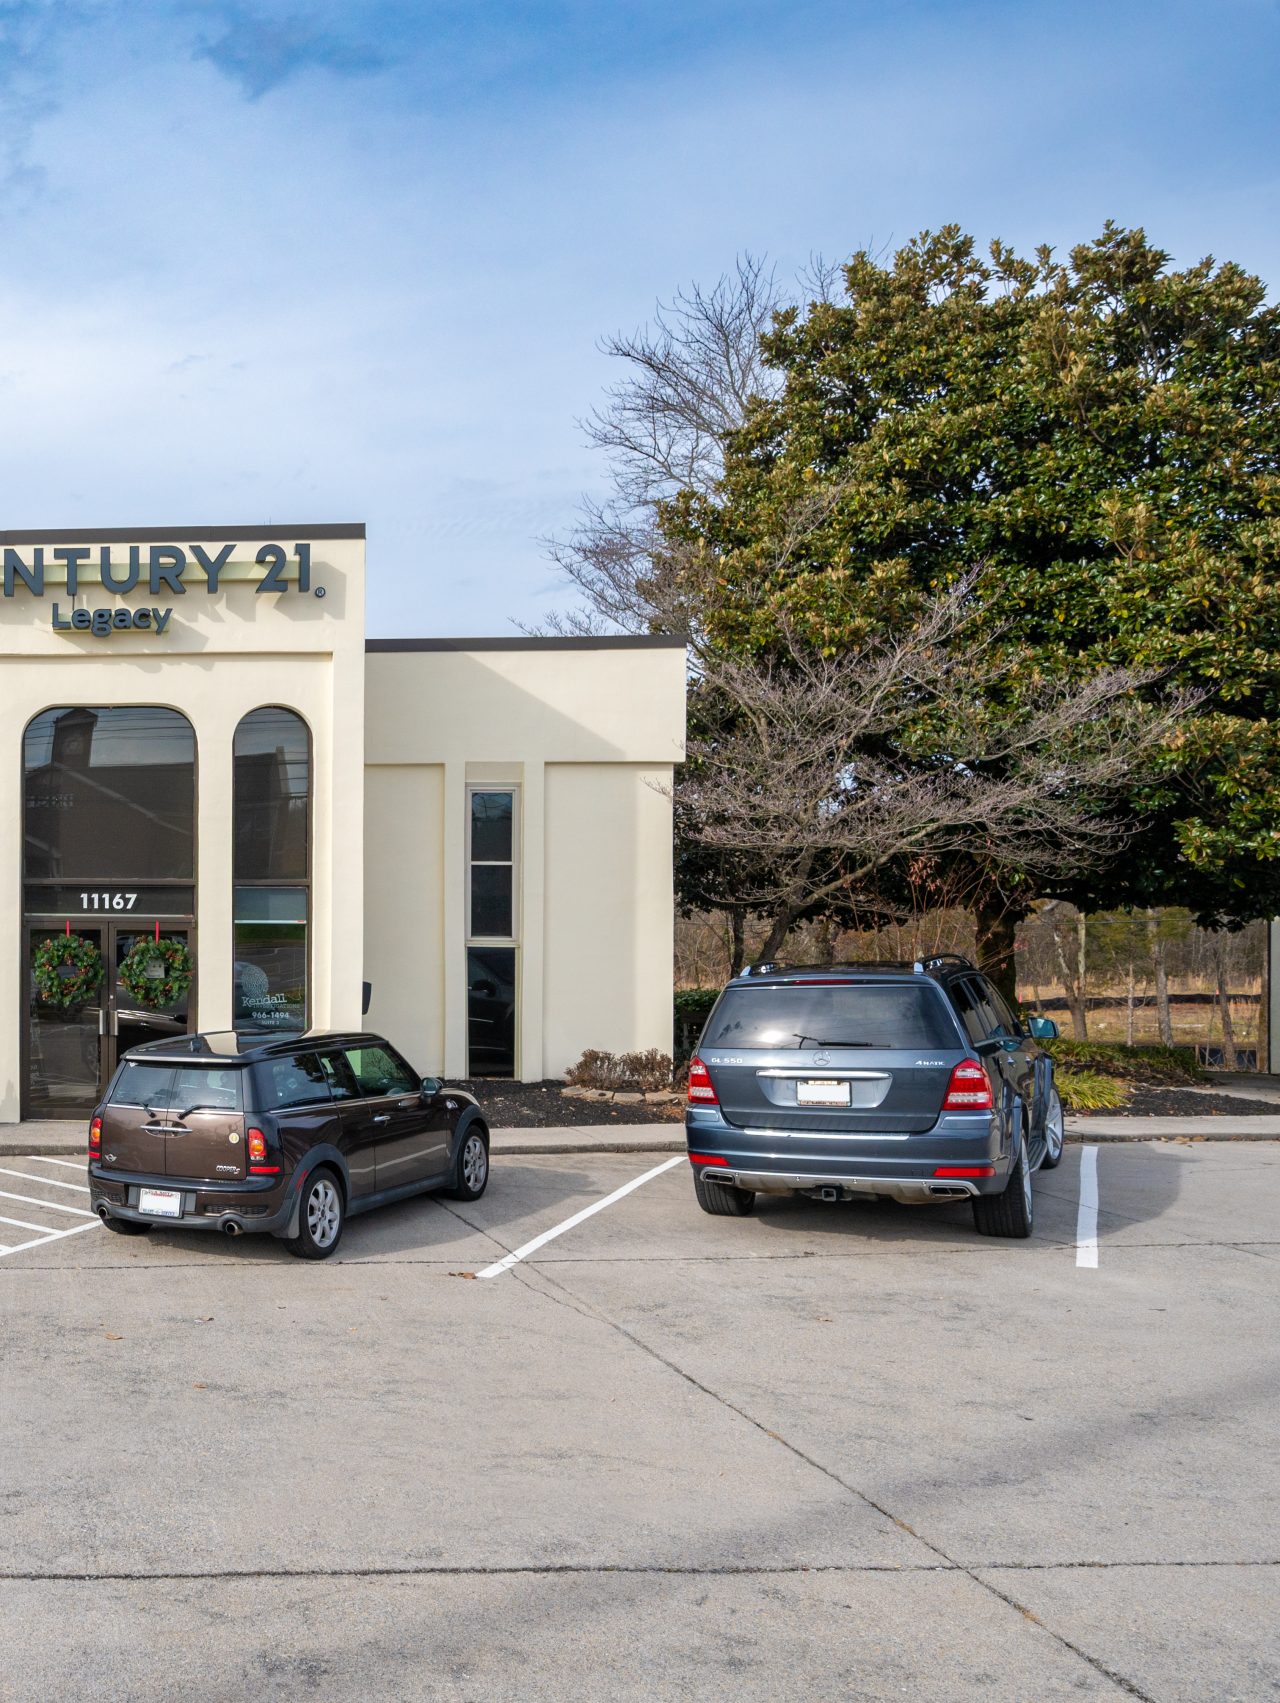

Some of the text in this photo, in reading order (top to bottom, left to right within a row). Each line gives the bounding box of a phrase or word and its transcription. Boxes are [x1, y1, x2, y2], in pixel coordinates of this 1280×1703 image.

[52, 602, 173, 637] Legacy
[80, 893, 138, 910] 11167
[242, 993, 287, 1007] Kendall
[251, 1011, 290, 1019] 966-1494
[216, 1165, 237, 1173] COOPER
